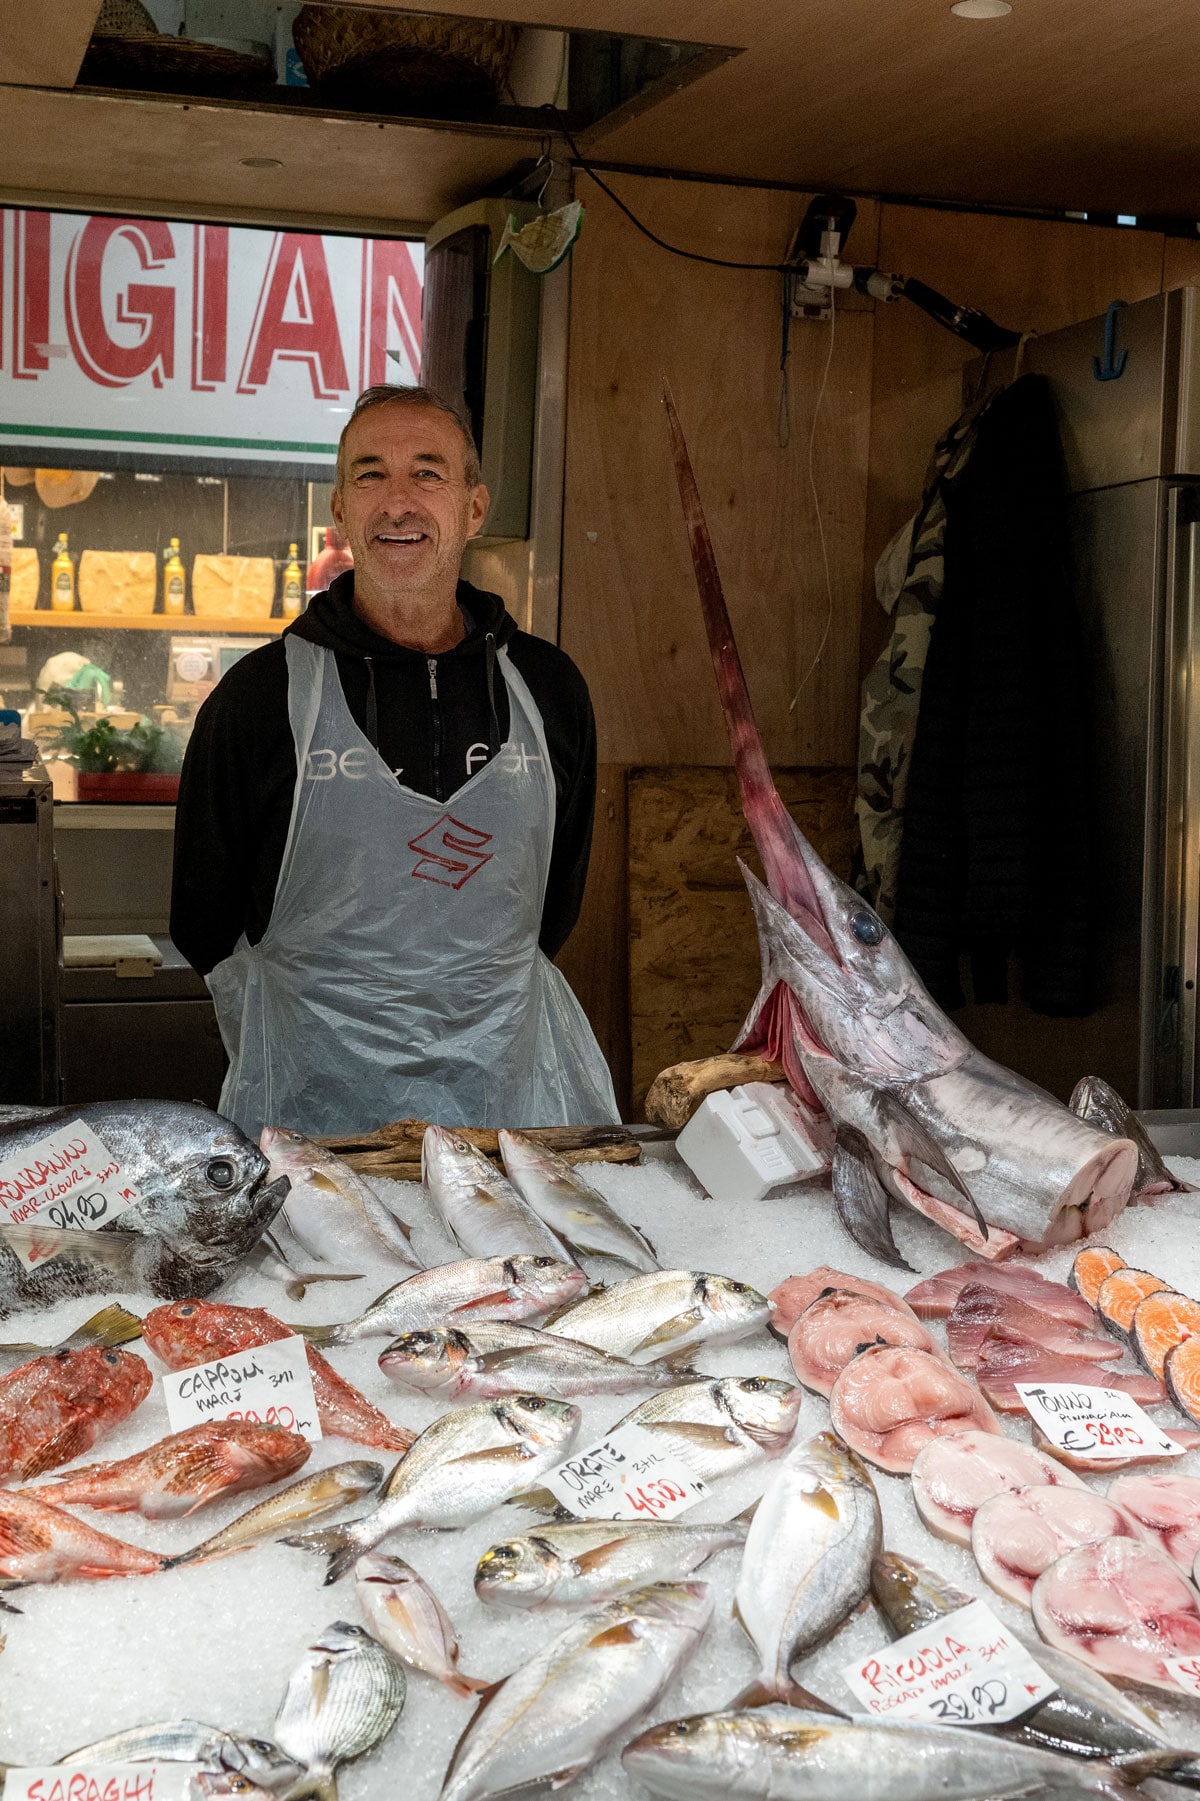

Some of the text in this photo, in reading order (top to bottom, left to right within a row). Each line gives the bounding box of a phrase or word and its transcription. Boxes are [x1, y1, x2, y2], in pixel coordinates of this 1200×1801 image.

[1024, 1388, 1092, 1413] TONNO
[1060, 1430, 1096, 1451] €
[558, 1441, 626, 1491] ORATE
[577, 1479, 614, 1509] MARE
